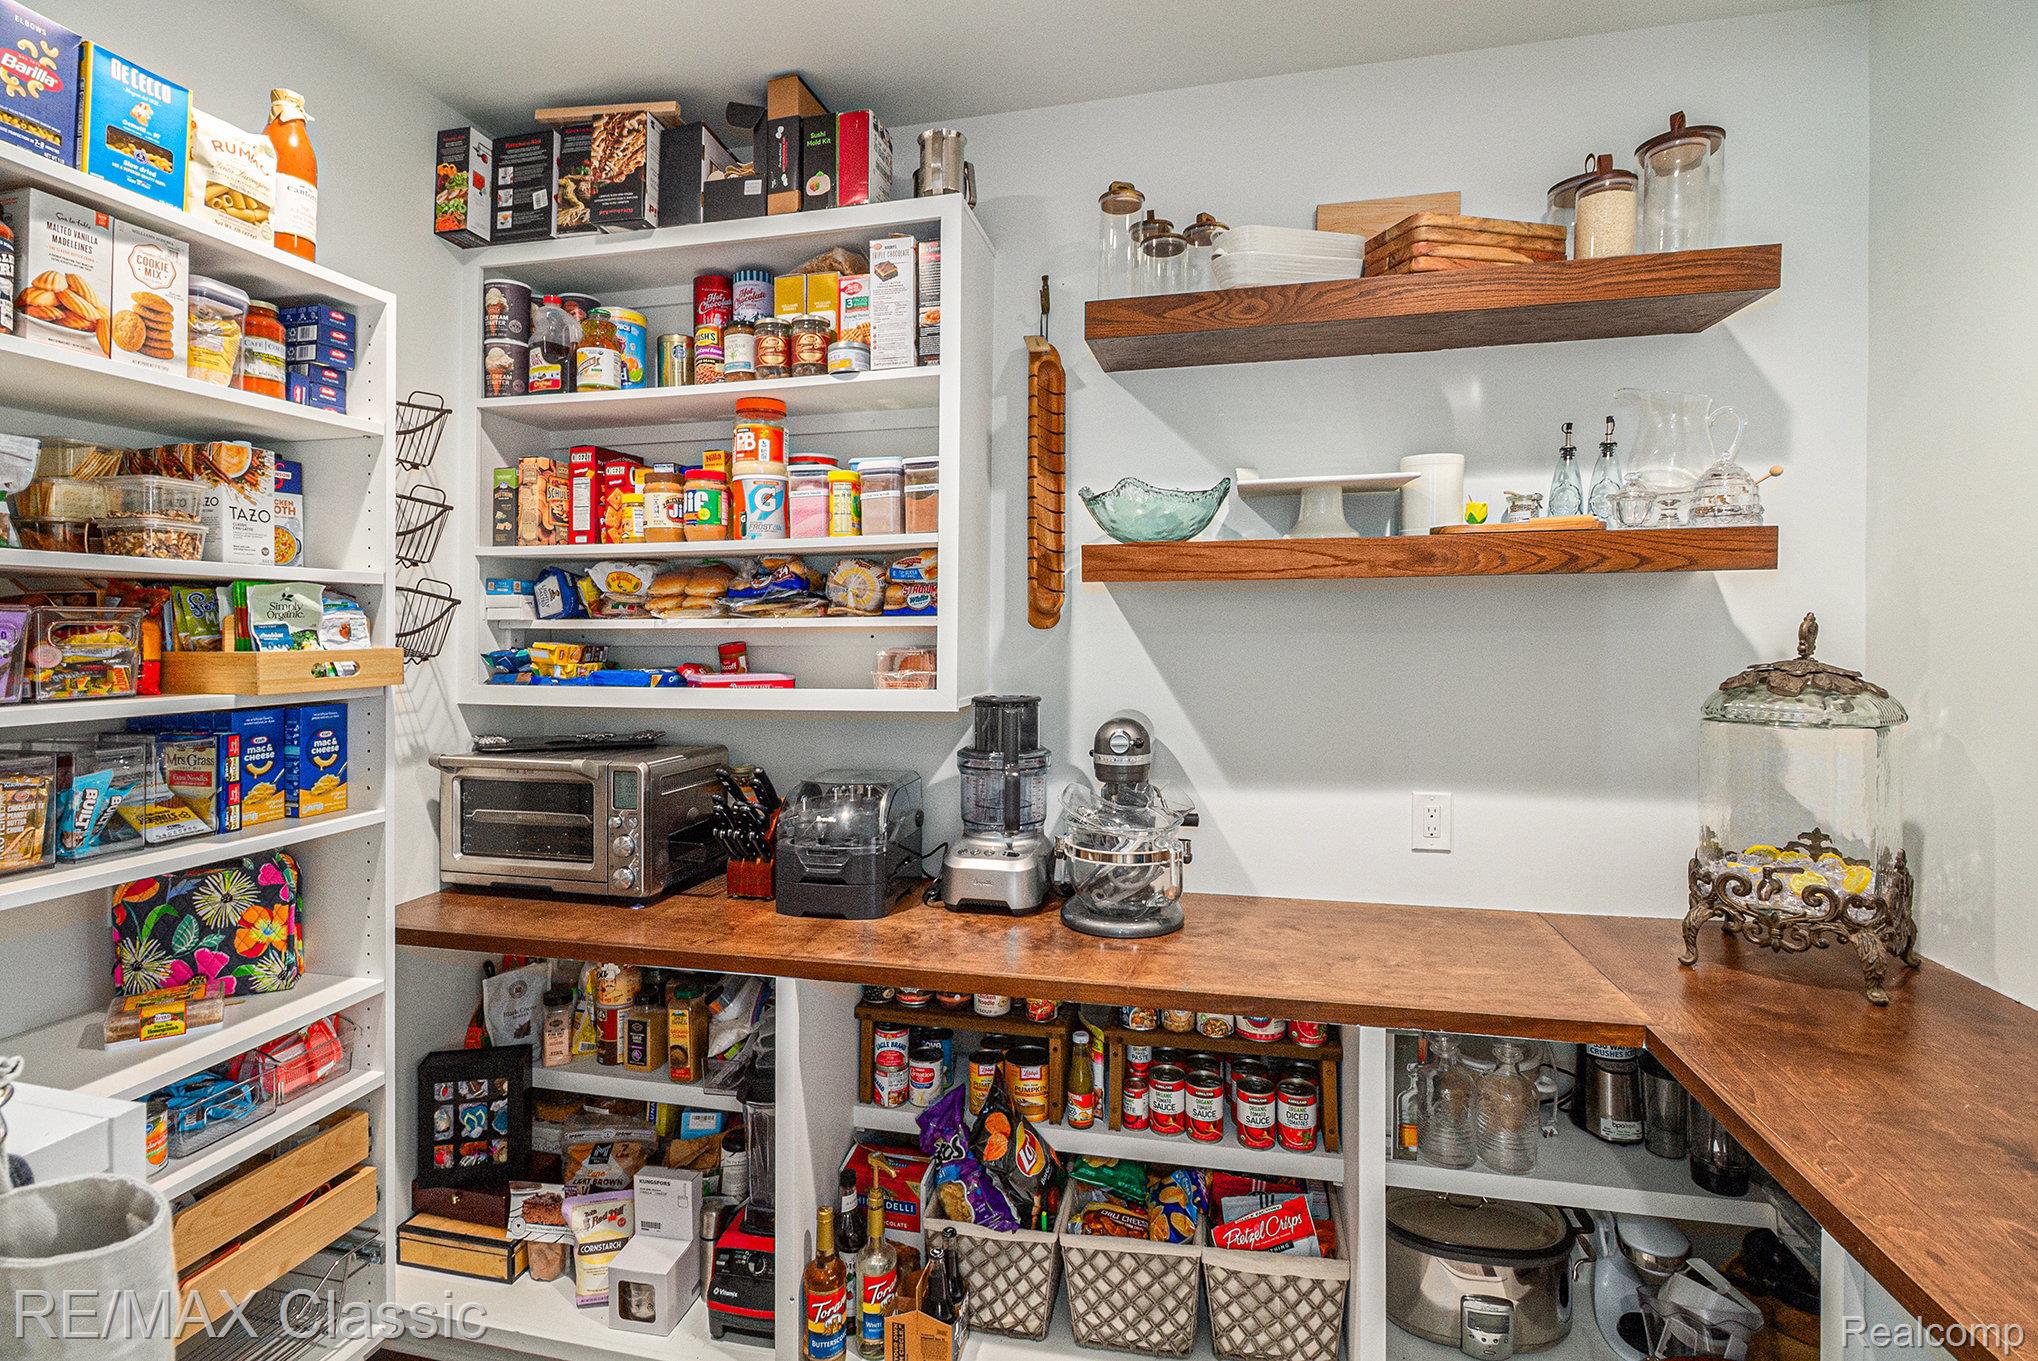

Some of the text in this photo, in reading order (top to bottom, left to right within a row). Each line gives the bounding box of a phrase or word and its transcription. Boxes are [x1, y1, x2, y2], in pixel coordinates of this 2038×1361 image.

[14, 15, 47, 36] ELBOWS
[1, 52, 57, 88] Barilla
[810, 131, 826, 139] Sushi
[807, 139, 821, 147] Mold
[46, 221, 98, 245] MALTED VANILLA
[51, 234, 94, 254] MADELEINES
[886, 249, 910, 258] CHOCOLATE
[136, 254, 169, 273] COOKIE
[144, 267, 163, 281] MIX
[739, 288, 755, 297] Hot
[707, 293, 724, 303] Hot
[846, 299, 854, 308] 3
[705, 454, 722, 462] Nilla
[205, 497, 219, 507] ZO
[274, 499, 294, 507] CKEN
[684, 491, 709, 513] Jif
[755, 487, 777, 511] G
[229, 506, 271, 523] TAZO
[274, 506, 296, 516] OTH
[748, 523, 772, 531] FROST
[269, 602, 304, 614] Simply
[314, 739, 332, 749] mac
[247, 746, 266, 755] mac
[75, 788, 99, 831] BUILT
[978, 998, 995, 1006] Noodle
[1590, 1047, 1624, 1058] CRUSHES
[1014, 1085, 1048, 1094] PUMPKIN
[1153, 1102, 1176, 1112] SAUCE
[1193, 1109, 1217, 1118] SAUCE
[1286, 1111, 1309, 1121] DICED
[1245, 1115, 1270, 1125] SAUCE
[593, 1178, 623, 1187] BROWN
[1101, 1209, 1120, 1220] CHILI
[592, 1212, 609, 1228] Red
[1223, 1213, 1302, 1249] Pretzel Crisps
[580, 1241, 622, 1254] CORNSTARCH
